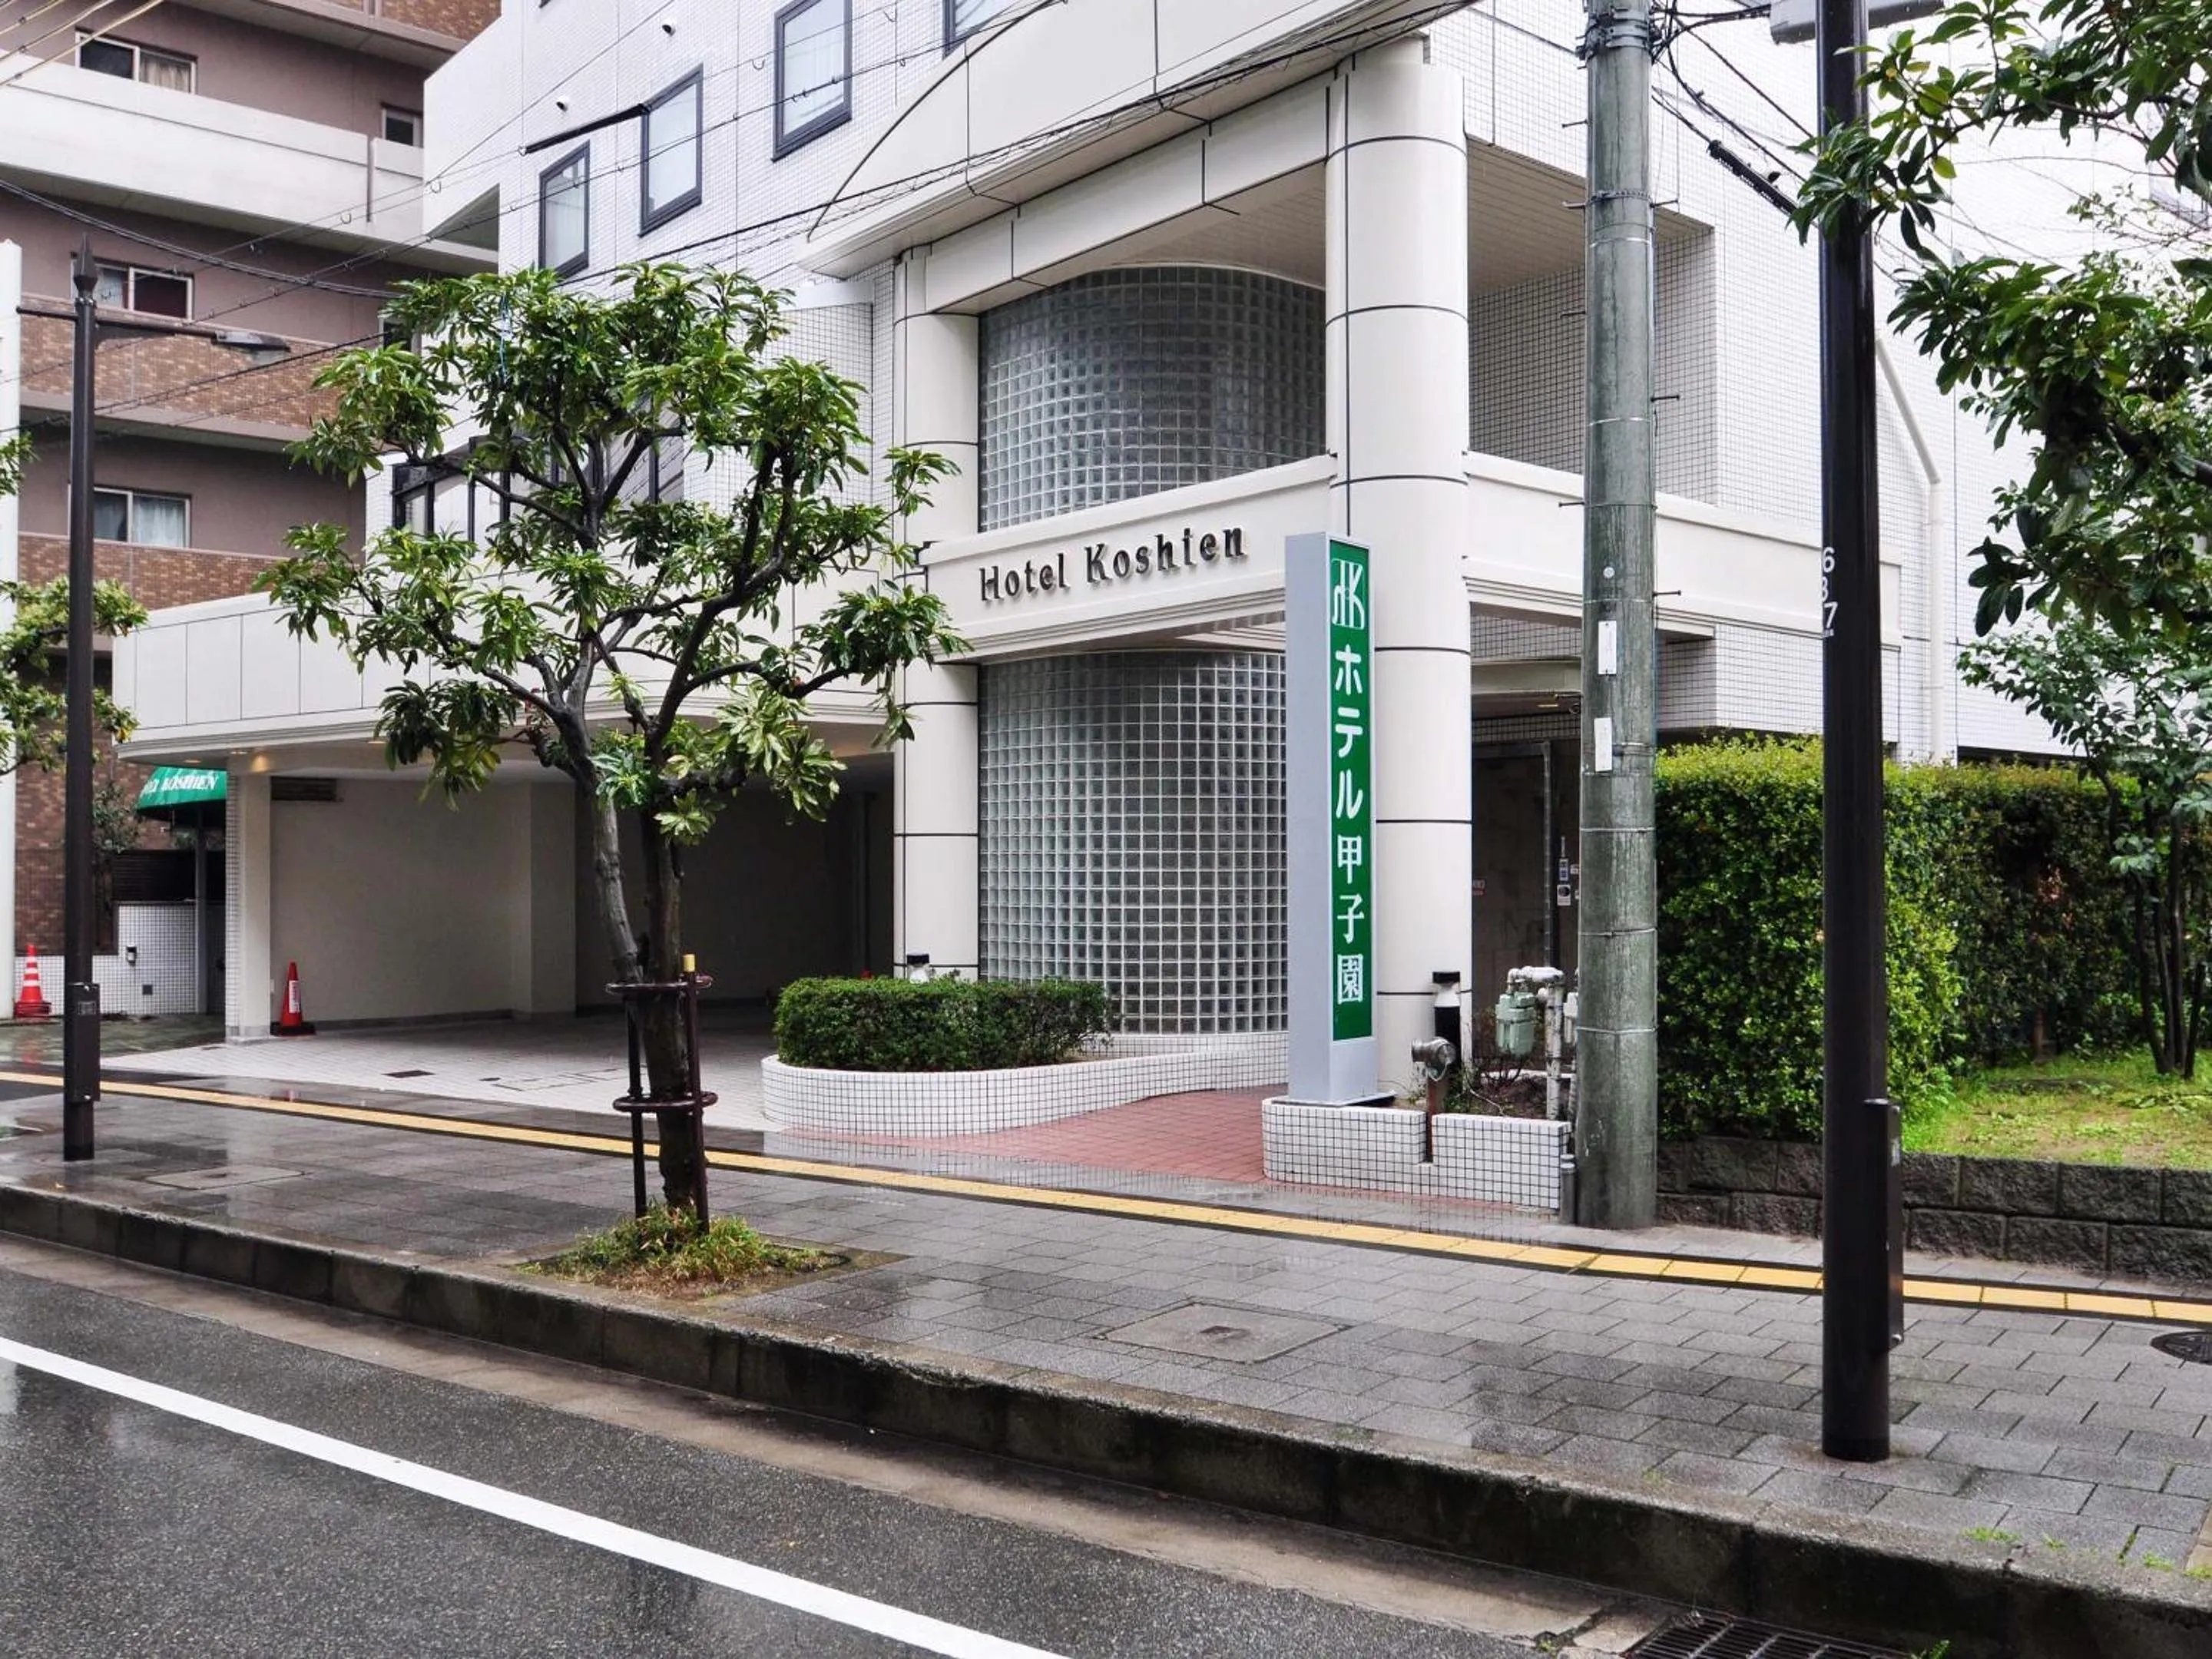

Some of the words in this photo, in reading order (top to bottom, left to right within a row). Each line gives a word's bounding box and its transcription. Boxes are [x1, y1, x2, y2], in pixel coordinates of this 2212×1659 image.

[979, 553, 1068, 601] Hotel
[1084, 527, 1245, 584] Koshien
[1333, 644, 1365, 1005] ホテル甲子園
